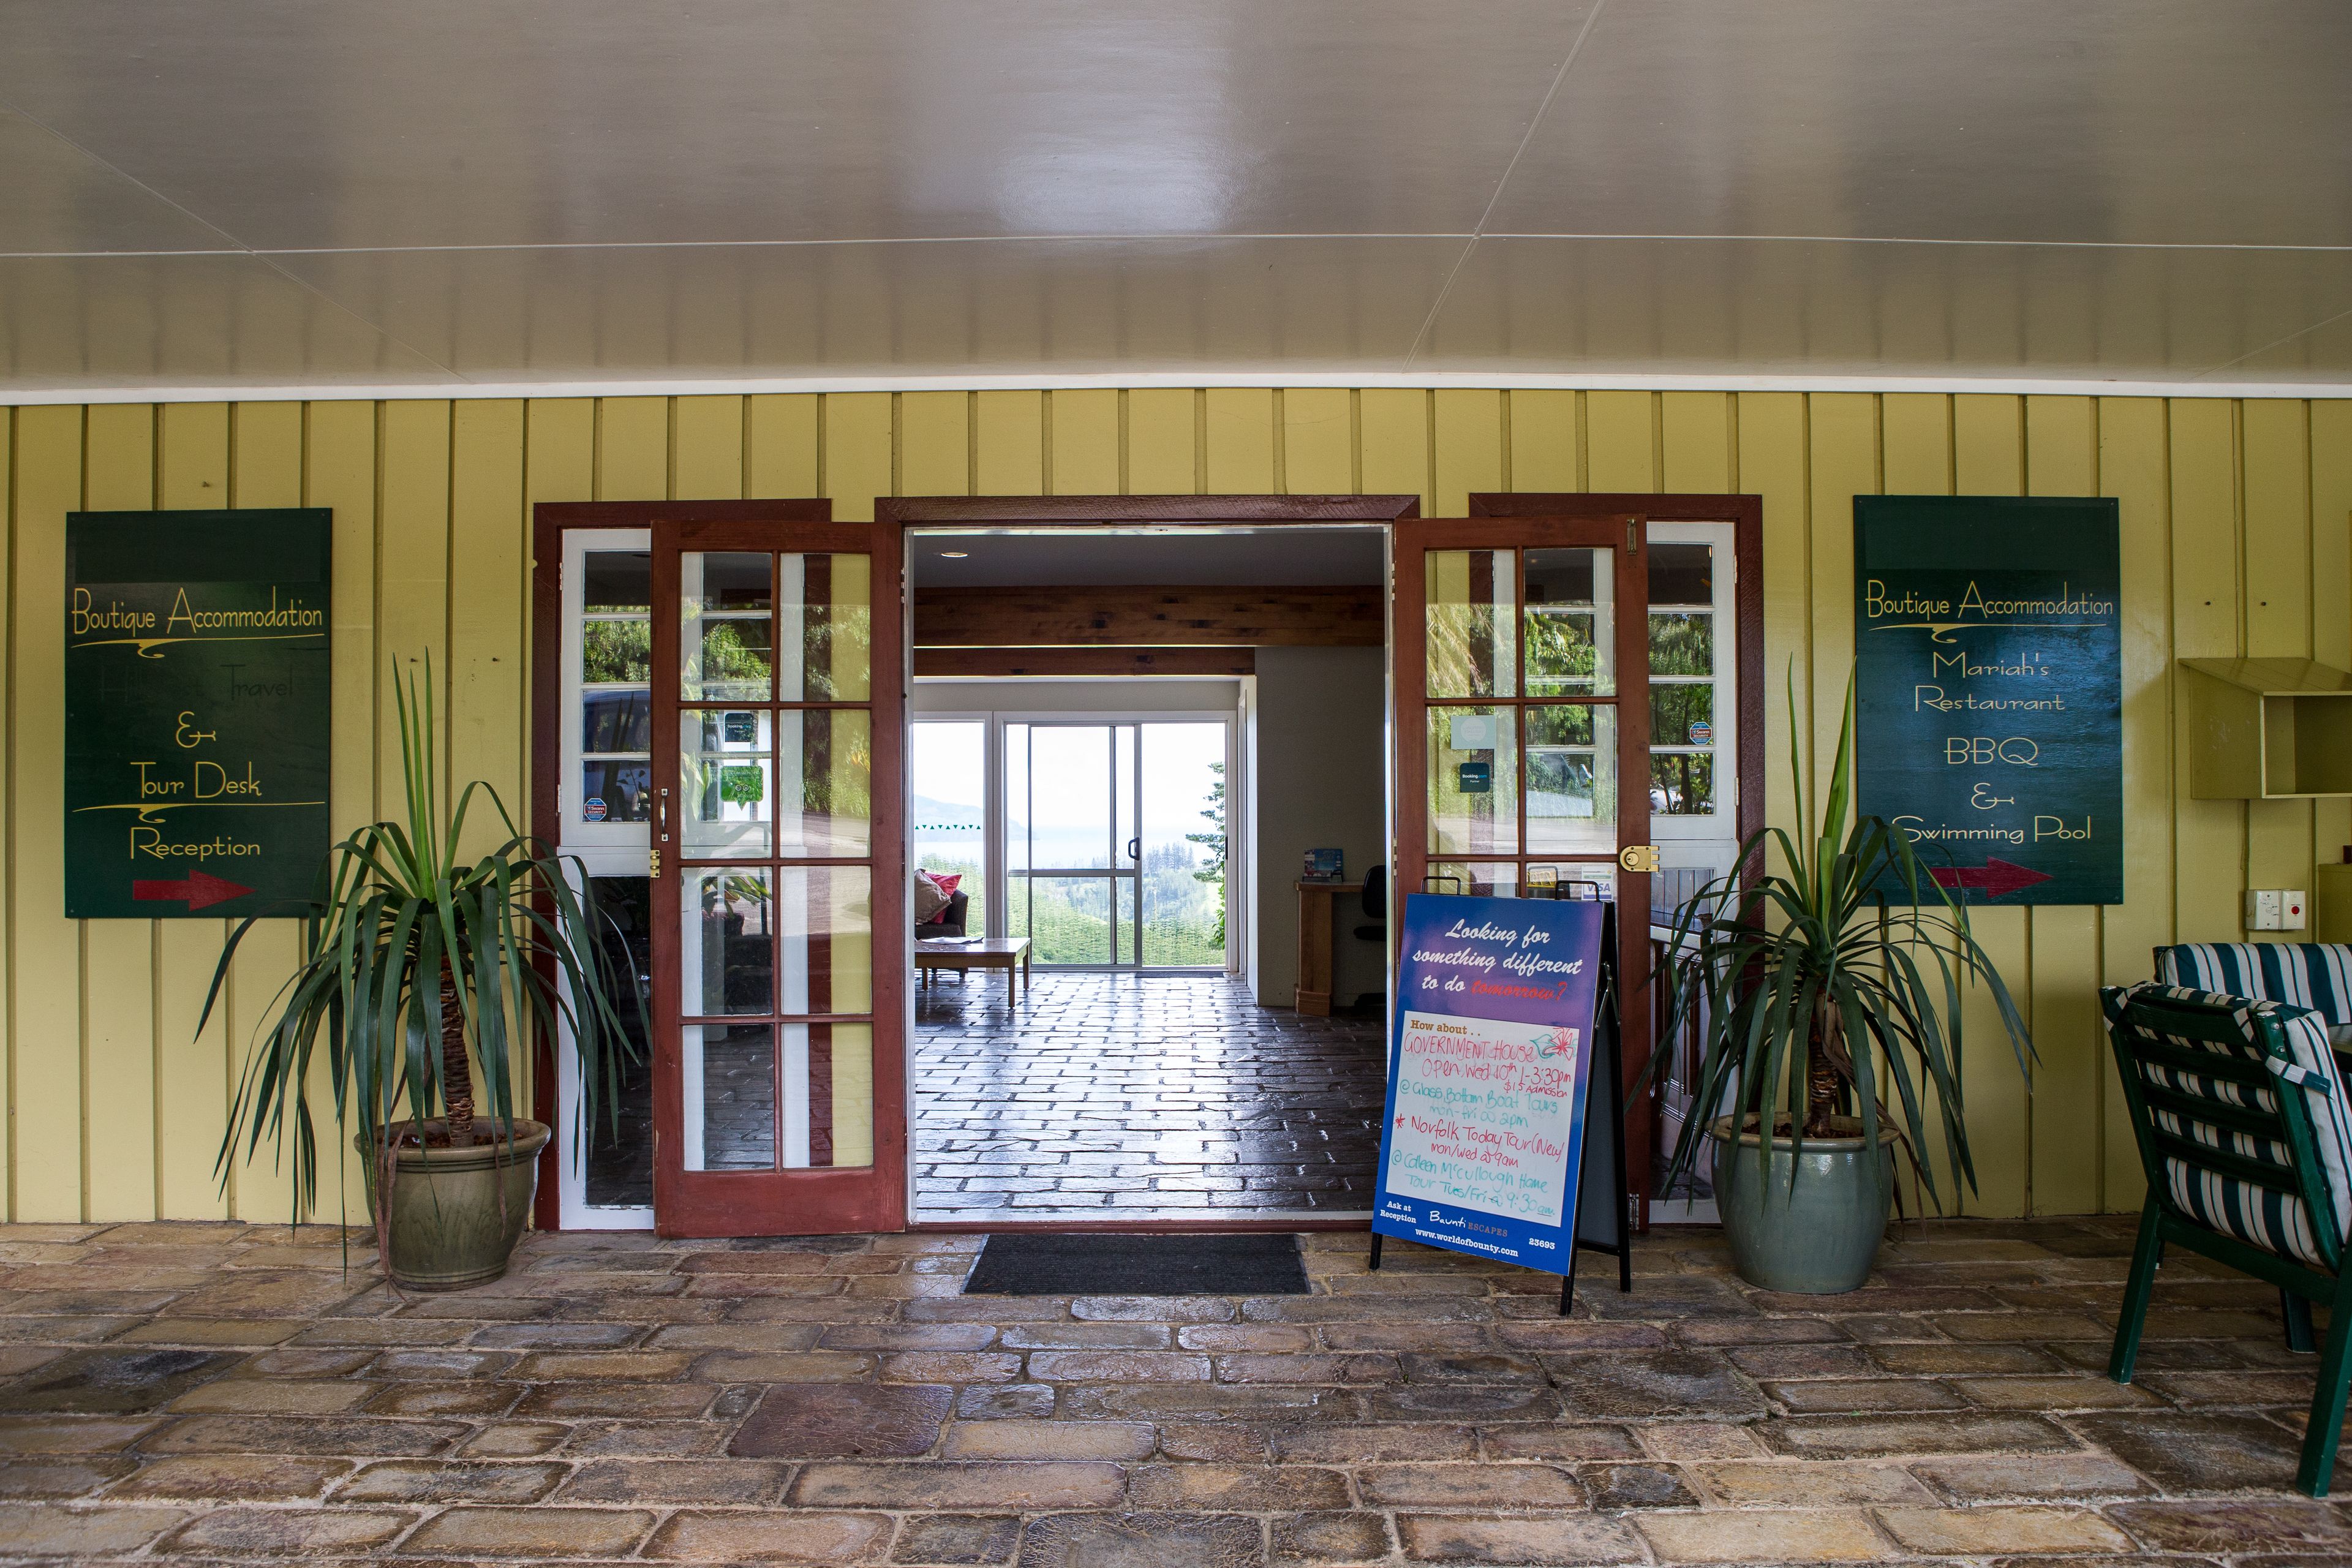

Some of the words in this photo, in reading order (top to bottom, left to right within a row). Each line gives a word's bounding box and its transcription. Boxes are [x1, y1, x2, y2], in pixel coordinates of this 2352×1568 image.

[72, 587, 155, 636] Boutique
[167, 586, 322, 633] Accommodation
[1865, 579, 1949, 620] Boutique
[1958, 581, 2113, 618] Accommodation
[1933, 652, 2049, 678] Mariah's
[1915, 685, 2065, 712] Restaurant
[176, 711, 216, 748] &
[1943, 737, 2039, 766] BBQ
[130, 761, 184, 797] Tour
[195, 761, 262, 797] Desk
[1970, 783, 2014, 810] &
[1892, 816, 2023, 844] Swimming
[2035, 816, 2091, 842] Pool
[130, 827, 260, 861] Reception
[1588, 883, 1610, 892] VSA
[1445, 919, 1518, 948] Looking
[1522, 925, 1550, 949] for
[1412, 948, 1496, 973] something
[1502, 952, 1583, 977] different
[1422, 975, 1438, 990] to
[1445, 974, 1465, 992] do
[1471, 979, 1567, 1001] tomorrow?
[1410, 1020, 1434, 1031] How
[1436, 1023, 1468, 1035] about
[1404, 1032, 1491, 1060] GOVERNMENT
[1486, 1090, 1519, 1109] Boat
[1504, 1082, 1525, 1093] $15
[1500, 1113, 1528, 1129] 2pm
[1411, 1116, 1460, 1141] Norfolk
[1463, 1126, 1502, 1156] Today
[1494, 1152, 1518, 1167] 9am
[1404, 1174, 1436, 1189] Tour
[1519, 1173, 1549, 1193] Home
[1379, 1209, 1417, 1224] Reception
[1386, 1200, 1401, 1211] Ask
[1430, 1210, 1466, 1228] Baunti
[1468, 1222, 1509, 1237] ESCAPES
[1415, 1227, 1519, 1257] www.worldofbounty.com
[1528, 1237, 1556, 1250] 23693
